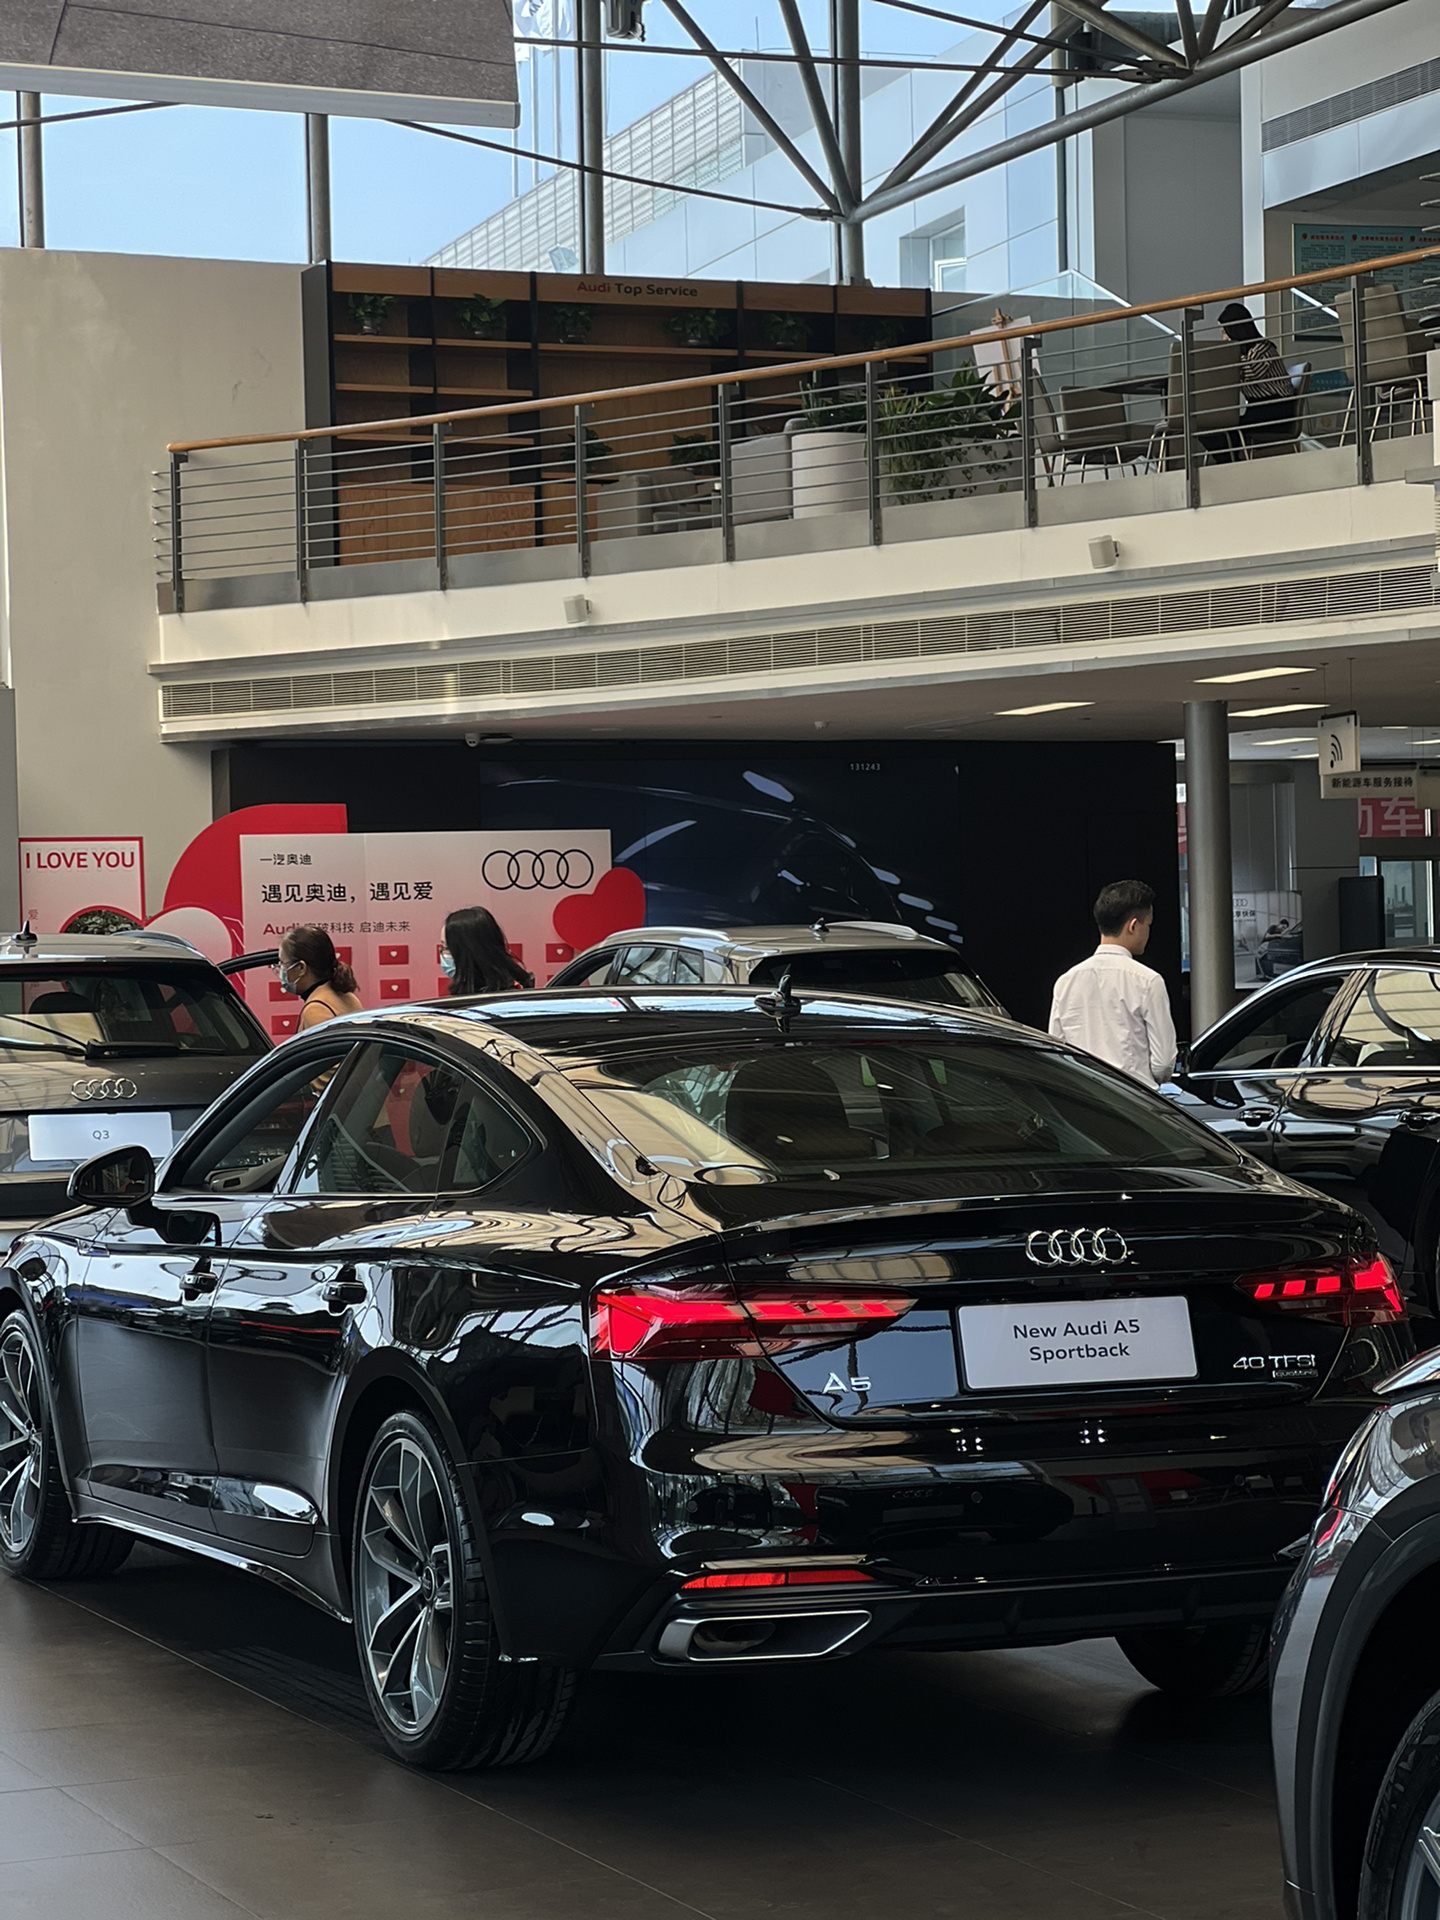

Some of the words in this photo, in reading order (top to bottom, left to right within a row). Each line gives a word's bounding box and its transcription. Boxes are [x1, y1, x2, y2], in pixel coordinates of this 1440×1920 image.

[577, 281, 611, 294] Audi
[615, 283, 642, 297] Top
[646, 284, 698, 297] Service
[850, 763, 881, 771] 131243
[1332, 776, 1413, 788] 新能源车服务接待
[26, 852, 30, 869] I
[37, 852, 88, 869] LOVE
[92, 851, 134, 868] YOU
[260, 853, 312, 866] 一汽奥迪
[359, 921, 411, 933] 启迪未来
[92, 1129, 110, 1140] Q3
[1013, 1324, 1057, 1339] New
[1063, 1320, 1107, 1337] Audi
[1113, 1318, 1140, 1335] A5
[1029, 1342, 1130, 1364] Sportback
[1233, 1356, 1265, 1370] 40
[1268, 1354, 1315, 1369] TFSI
[822, 1372, 872, 1395] A5
